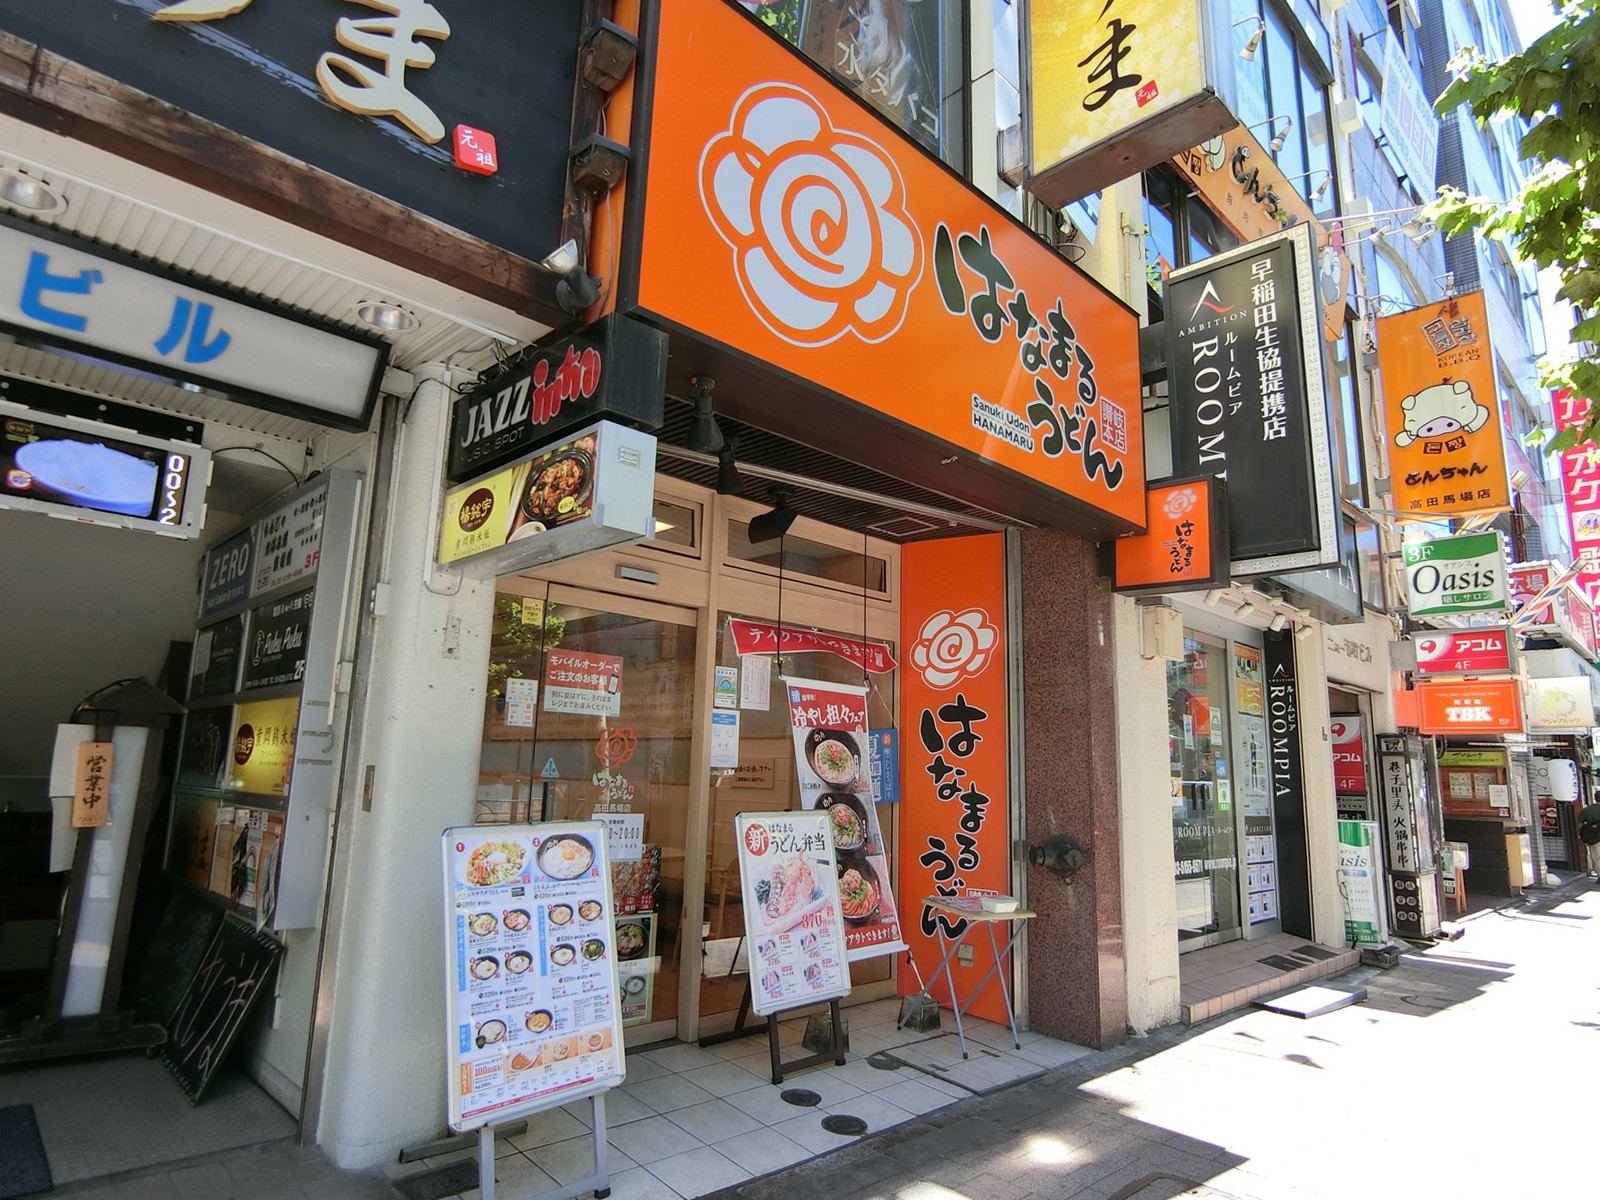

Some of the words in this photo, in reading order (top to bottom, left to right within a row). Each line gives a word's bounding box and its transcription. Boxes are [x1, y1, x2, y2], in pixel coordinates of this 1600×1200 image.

[459, 127, 498, 169] 元祖
[18, 250, 233, 364] ビル
[934, 221, 1097, 407] はなまる
[1178, 310, 1248, 338] AMBITION
[1250, 257, 1287, 442] 早稲田生協提携店
[1437, 347, 1479, 362] KOREAN
[1223, 331, 1243, 417] ルームピア
[460, 375, 532, 449] JAZZ
[973, 396, 1004, 421] Sanuki
[1006, 413, 1030, 434] Udon
[1191, 333, 1228, 481] ROOM
[494, 425, 526, 451] SPOT
[973, 413, 1034, 451] HANAMARU
[1027, 378, 1124, 492] うどん
[1409, 488, 1491, 510] 高田馬場店
[1174, 518, 1196, 567] はなまる
[1407, 545, 1435, 562] 3F
[209, 542, 250, 590] ZERO
[304, 550, 319, 569] 3F
[1168, 545, 1184, 574] うどん
[1412, 562, 1495, 595] Oasis
[1456, 638, 1503, 653] アコム
[549, 669, 608, 686] ご注文のお客様
[550, 655, 621, 673] モバイルオーダーで
[1454, 660, 1472, 670] 4F
[1285, 685, 1297, 733] ルームピア
[1445, 706, 1493, 723] TBK
[1269, 685, 1291, 798] ROOMPIA
[82, 754, 107, 809] 営業中
[592, 769, 629, 789] はなまる
[919, 692, 990, 873] はなまる
[1339, 778, 1356, 789] 4F
[593, 803, 632, 813] 高田馬場店
[610, 788, 634, 801] うどん
[748, 826, 766, 852] 新
[768, 822, 794, 834] はなまる
[770, 832, 826, 856] うどん弁当
